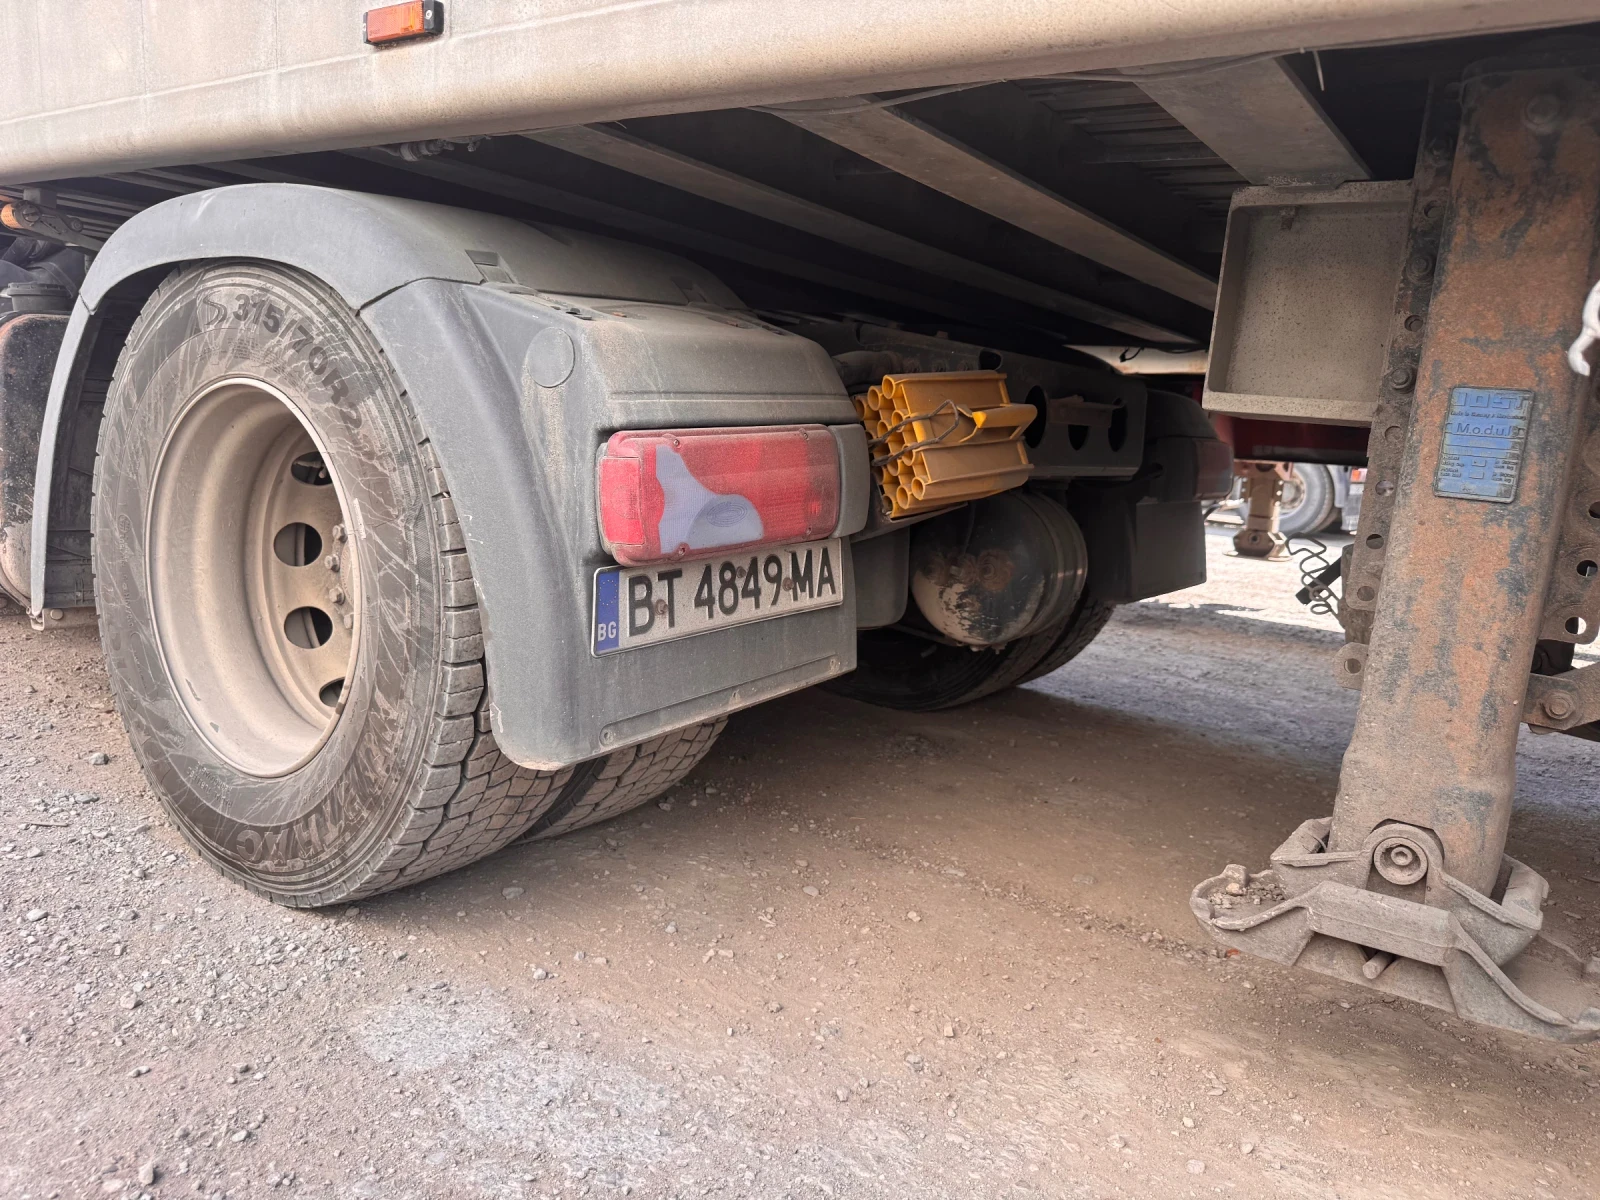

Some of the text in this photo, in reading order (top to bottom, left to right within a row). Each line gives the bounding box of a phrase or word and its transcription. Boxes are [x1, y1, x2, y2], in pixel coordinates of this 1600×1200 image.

[628, 547, 838, 638] BT 4849 MA
[597, 621, 617, 643] BG
